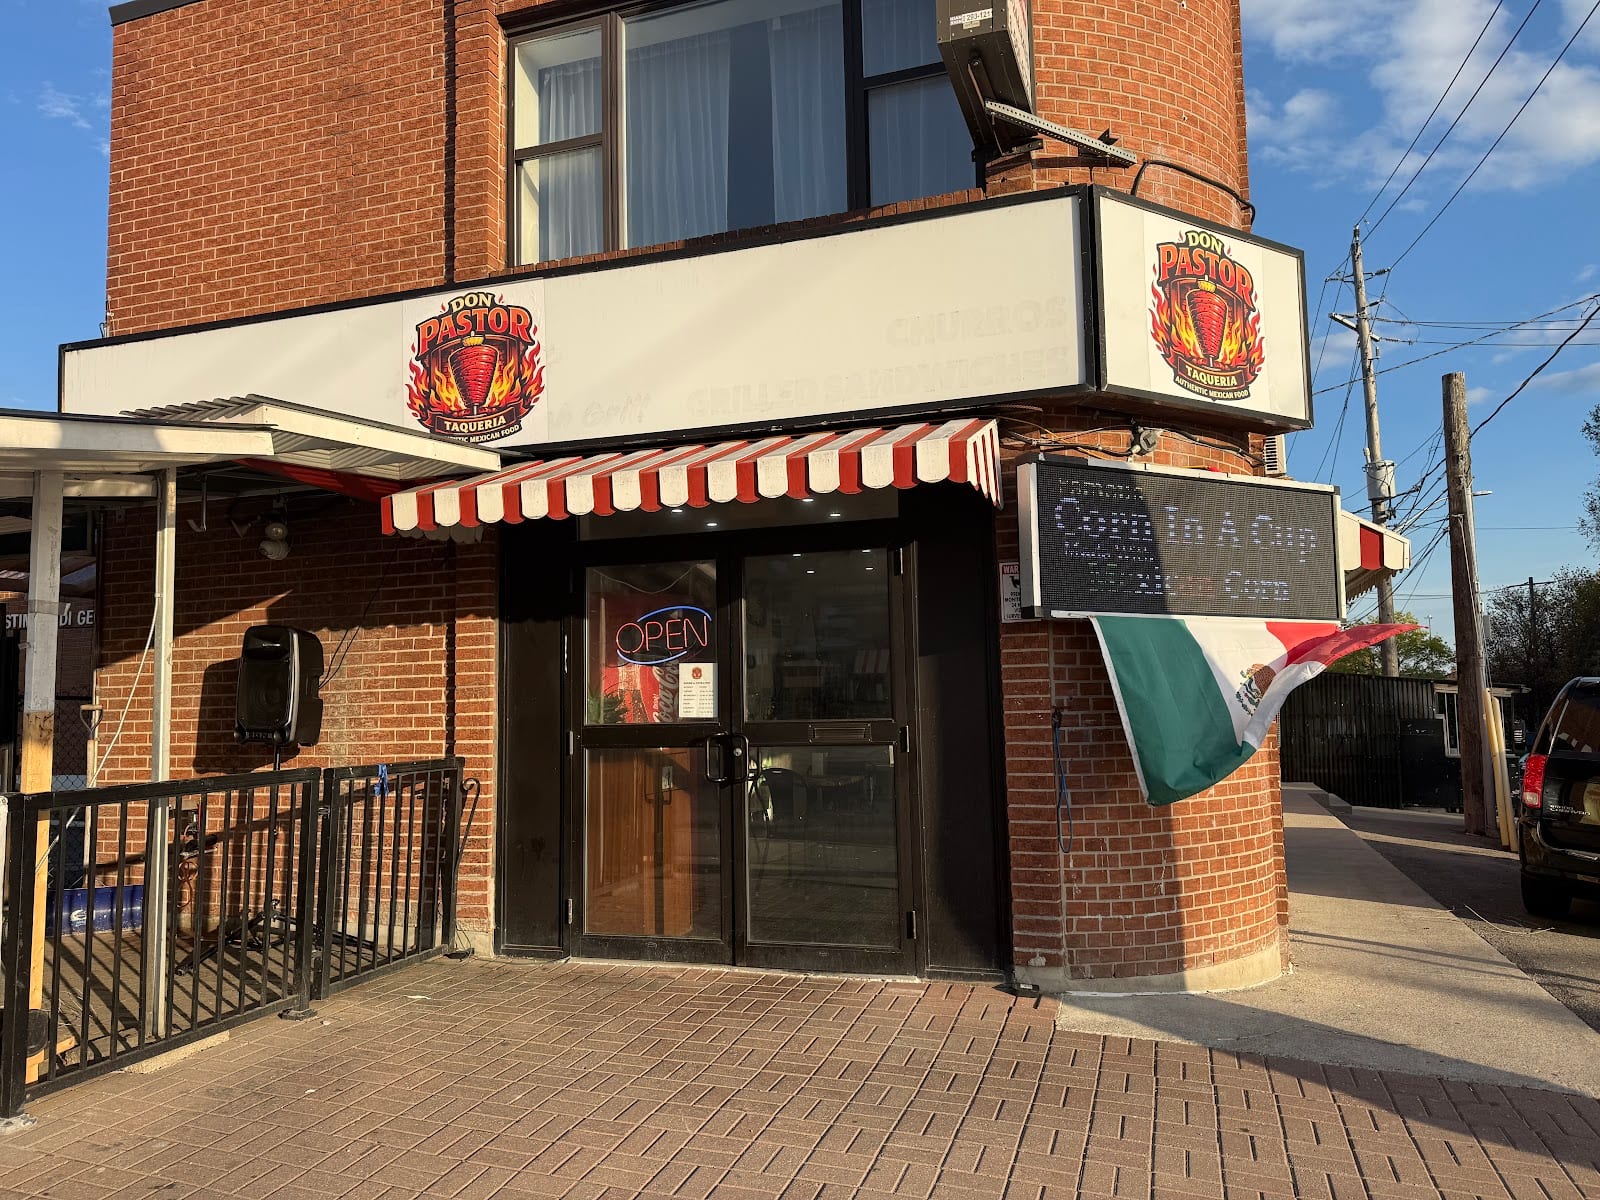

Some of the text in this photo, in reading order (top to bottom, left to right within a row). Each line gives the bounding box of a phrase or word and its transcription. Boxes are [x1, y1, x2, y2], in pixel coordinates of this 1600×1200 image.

[1186, 232, 1222, 255] DON
[1159, 245, 1254, 307] PASTOR
[451, 293, 494, 313] DON
[418, 306, 532, 356] PASTOR
[1175, 376, 1249, 399] AUTHENTIC MEXICAN FOOD
[1186, 365, 1238, 387] TAQUERIA
[444, 416, 507, 433] TAQUERIA
[470, 432, 500, 443] MEXICAN
[501, 424, 519, 437] FOOD
[1164, 506, 1206, 545] In
[1216, 511, 1243, 548] A
[1251, 513, 1318, 563] Cup
[5, 612, 29, 630] STIN
[77, 609, 96, 625] GE
[616, 616, 708, 653] OPEN
